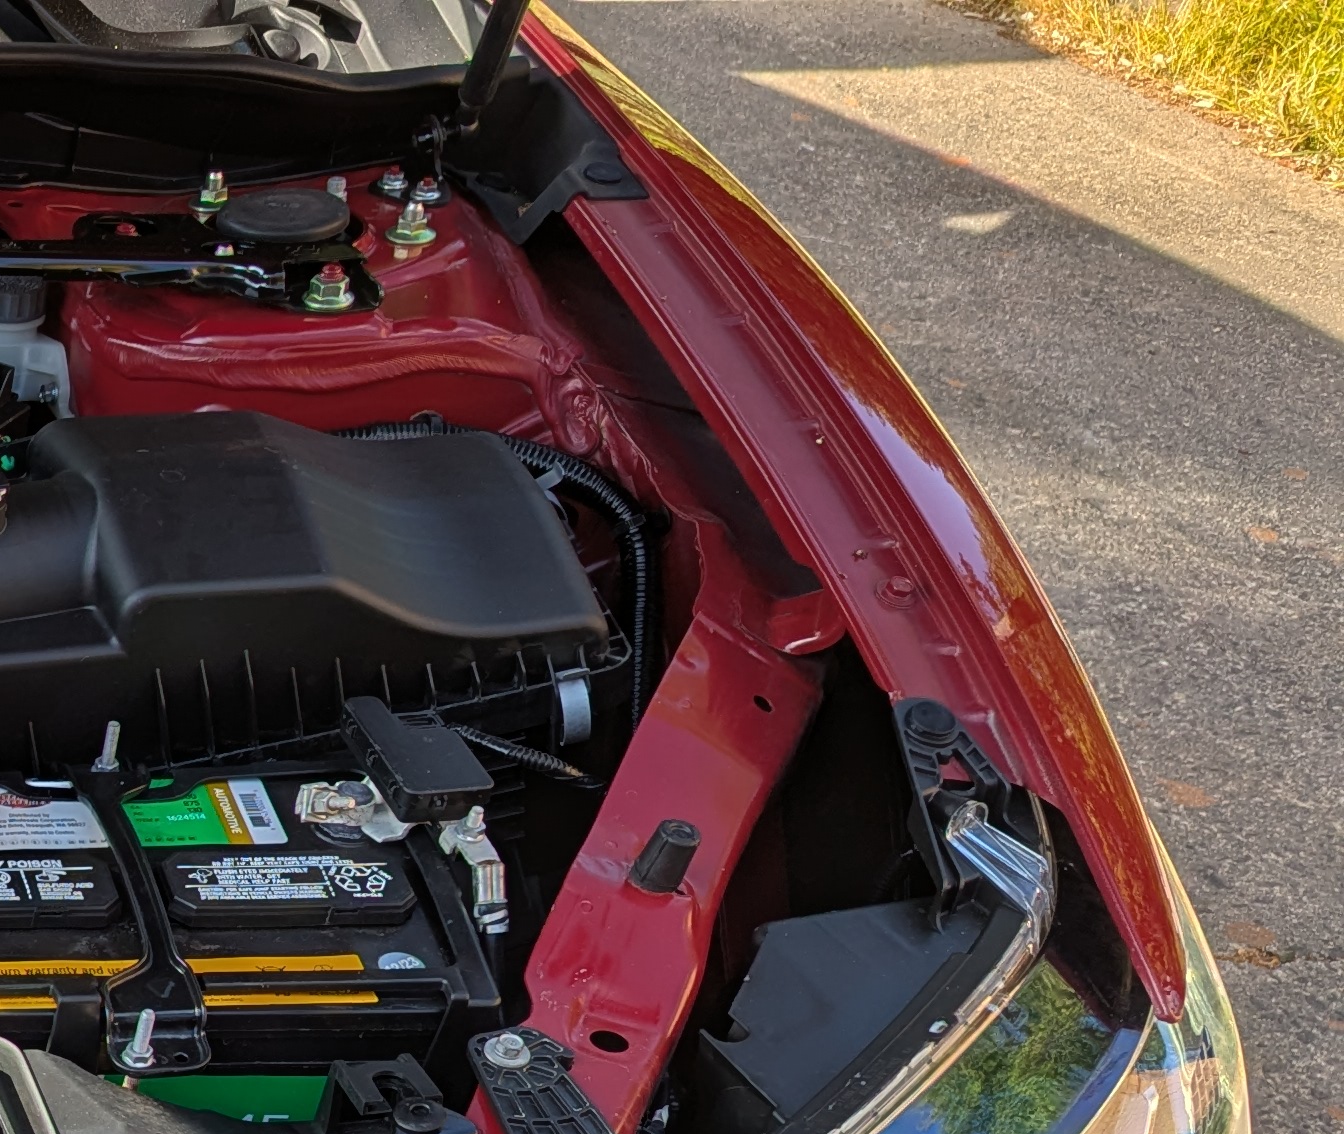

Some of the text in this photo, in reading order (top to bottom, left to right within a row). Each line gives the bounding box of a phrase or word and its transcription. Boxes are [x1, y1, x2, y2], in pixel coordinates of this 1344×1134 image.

[214, 788, 243, 834] AUTOMOTIVE
[166, 813, 206, 821] 1624514
[7, 859, 62, 868] POISON
[23, 966, 77, 976] warranty
[82, 966, 104, 974] and
